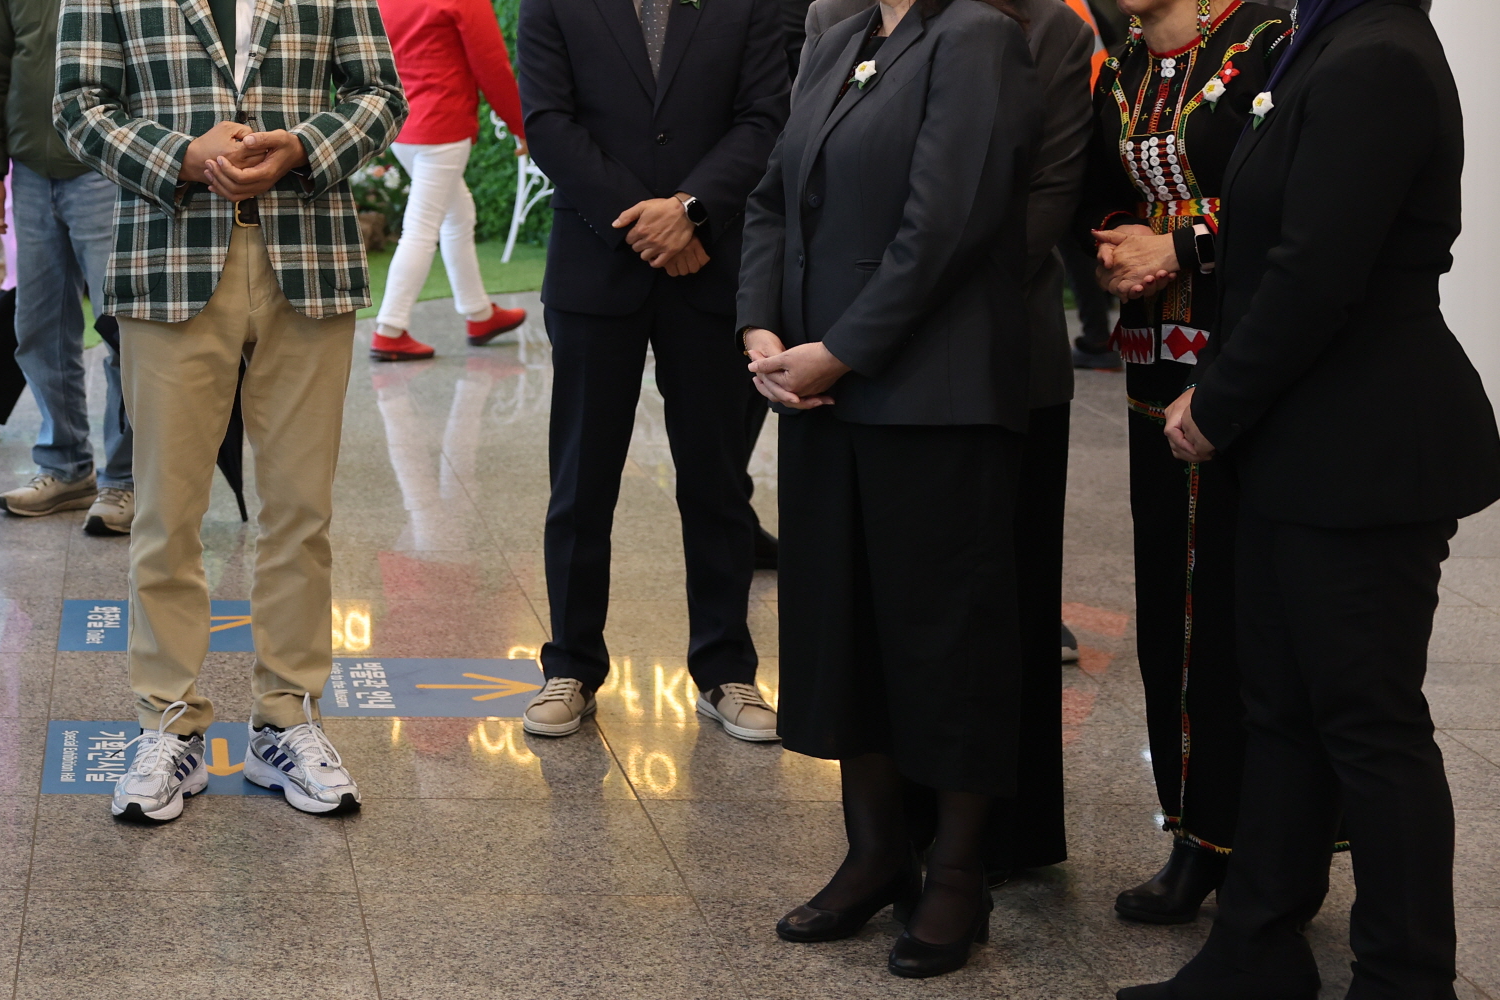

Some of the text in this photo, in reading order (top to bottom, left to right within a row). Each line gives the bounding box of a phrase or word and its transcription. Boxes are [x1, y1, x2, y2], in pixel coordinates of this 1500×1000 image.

[85, 606, 122, 645] 화장실 Toilet
[332, 680, 348, 689] the
[349, 662, 390, 689] 박물관
[334, 689, 350, 708] Museum
[355, 690, 397, 709] 안내
[60, 730, 80, 783] Special Exhibition Hall
[85, 731, 127, 782] 기획전시실
